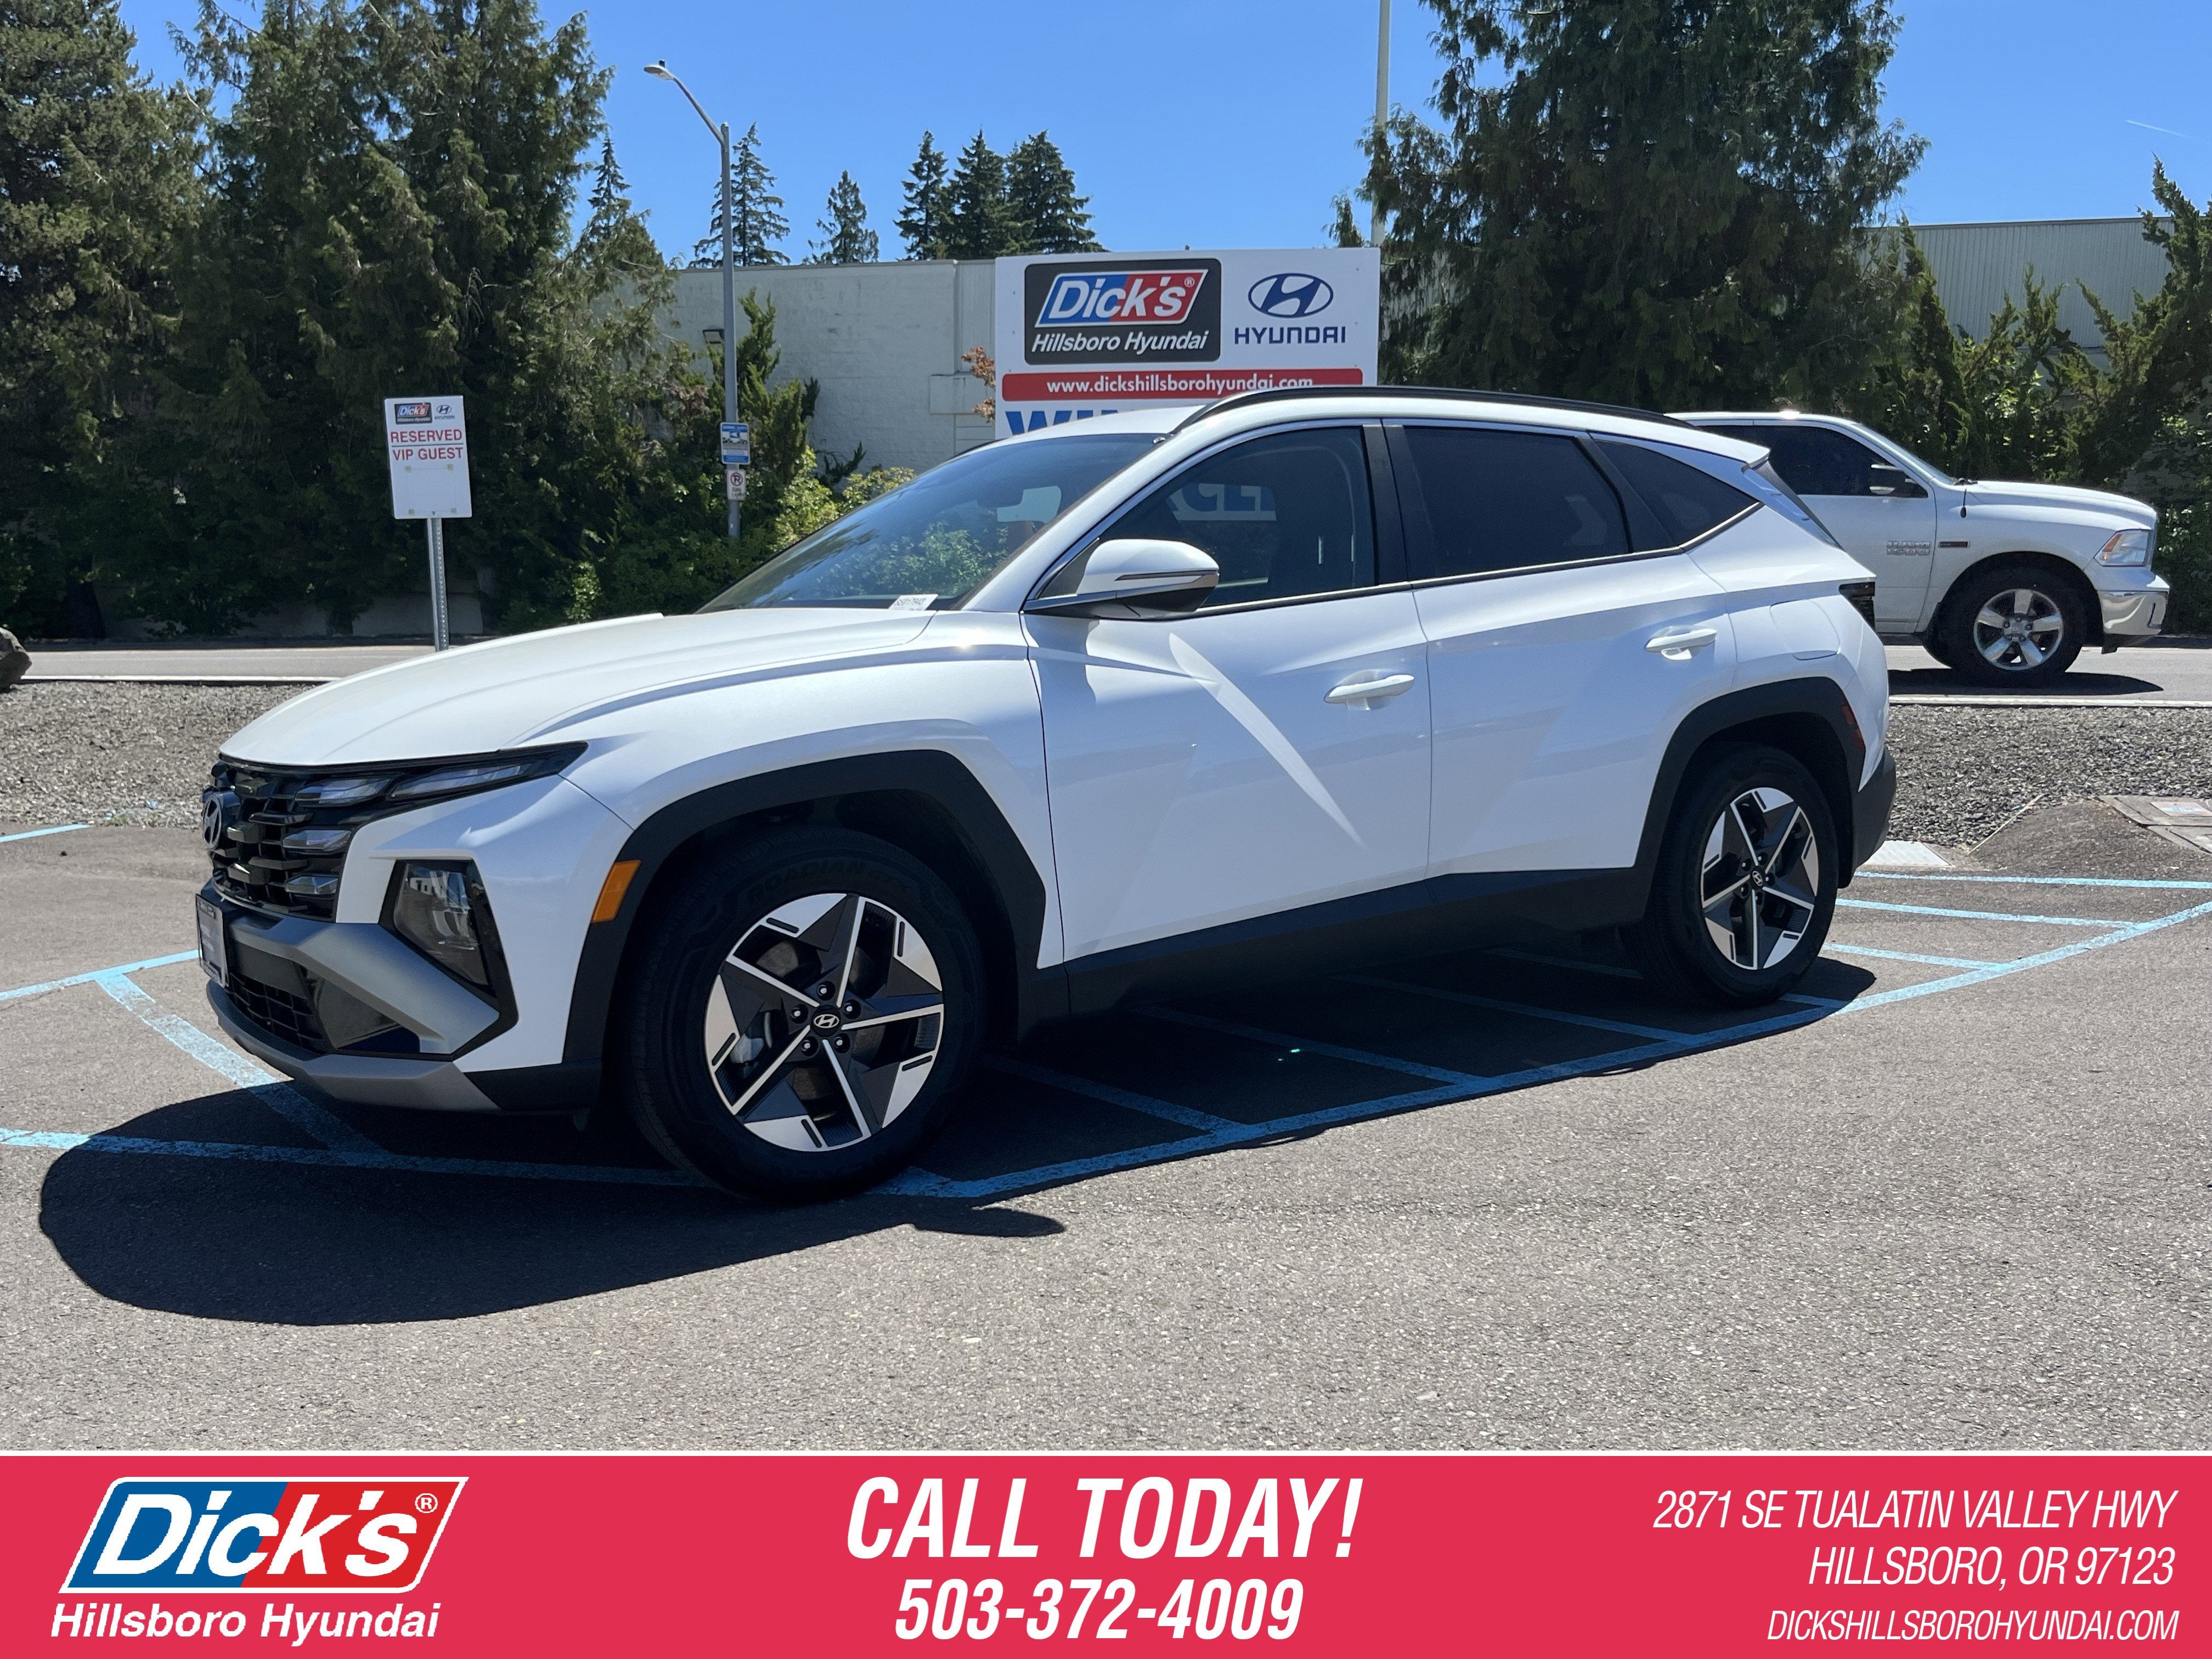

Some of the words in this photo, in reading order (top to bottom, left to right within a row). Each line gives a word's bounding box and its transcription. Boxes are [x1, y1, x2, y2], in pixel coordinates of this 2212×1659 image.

[1031, 332, 1121, 353] Hillsboro
[1125, 330, 1210, 355] Hyundai
[1234, 326, 1346, 345] HYUNDAI
[391, 429, 462, 443] RESERVED
[393, 449, 414, 461] VIP
[418, 447, 464, 460] GUEST
